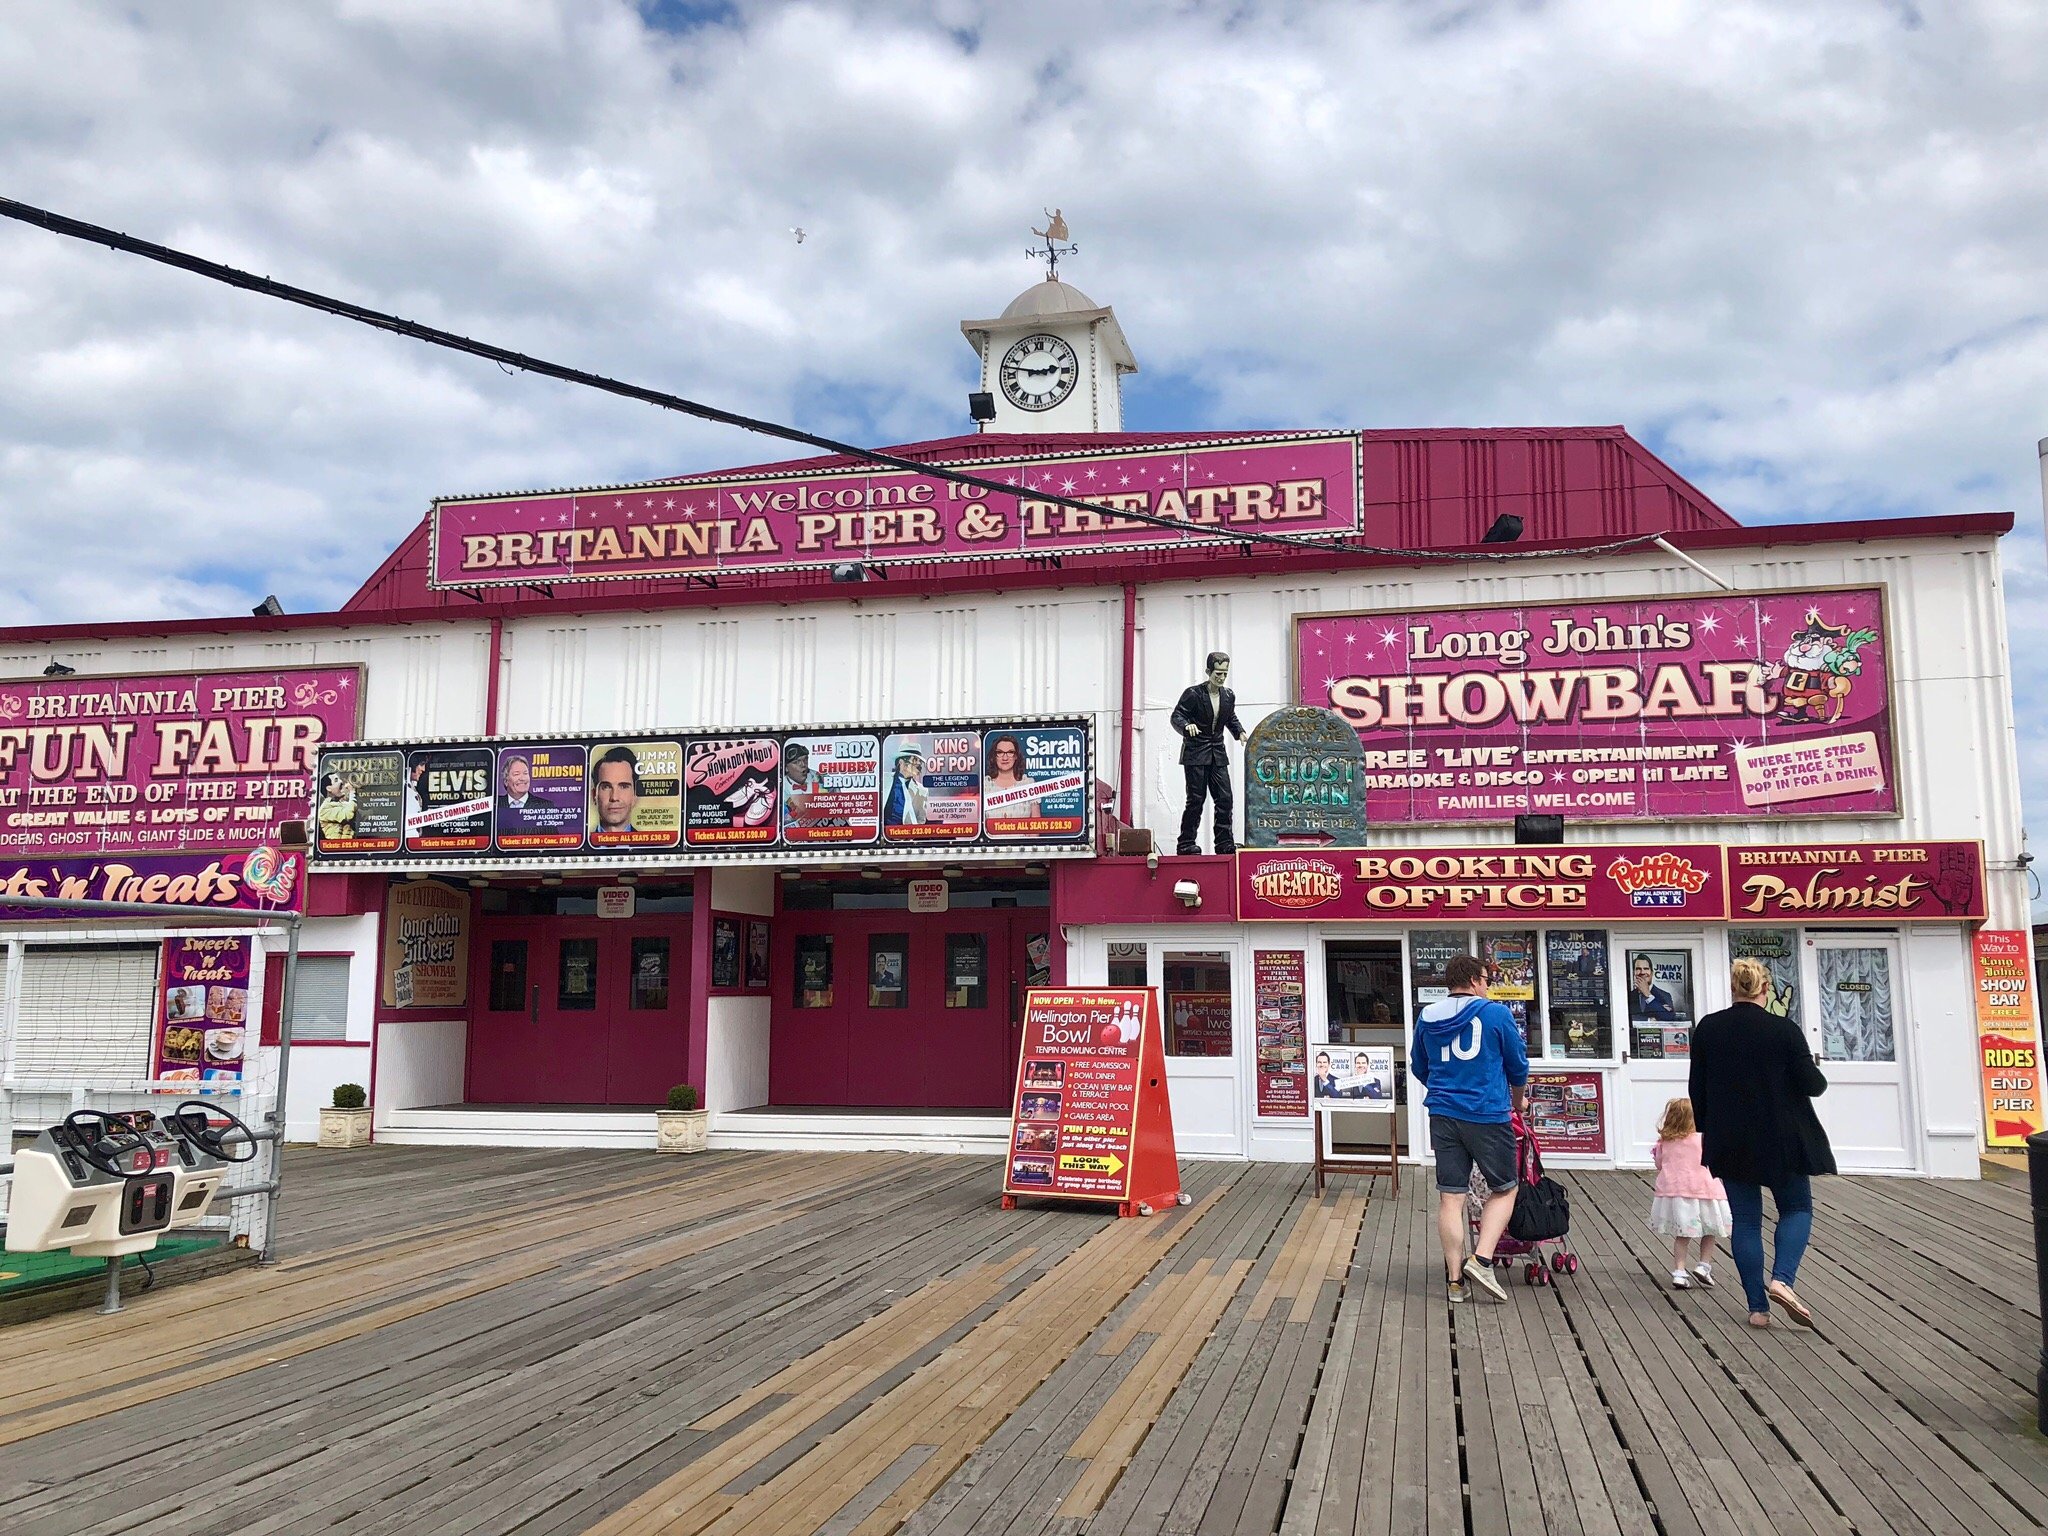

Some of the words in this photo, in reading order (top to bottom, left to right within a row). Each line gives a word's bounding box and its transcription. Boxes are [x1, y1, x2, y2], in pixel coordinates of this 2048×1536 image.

[1026, 247, 1036, 259] N
[1072, 244, 1078, 254] S
[730, 475, 935, 514] Welcome
[462, 517, 779, 571] BRITANNIA
[797, 506, 943, 553] PIER
[957, 501, 1006, 540] &
[1024, 478, 1325, 538] THEATRE
[1408, 624, 1530, 665] Long
[1542, 614, 1692, 655] John's
[1331, 661, 1778, 728] SHOWBAR
[27, 690, 198, 720] BRITANNIA
[212, 687, 286, 711] PIER
[0, 722, 137, 781] FUN
[152, 715, 326, 778] FAIR
[812, 744, 833, 753] LIVE
[835, 741, 874, 759] ROY
[934, 738, 968, 754] KING
[1026, 735, 1080, 756] Sarah
[532, 753, 550, 765] JIM
[636, 750, 677, 761] JIMMY
[1366, 749, 1428, 769] REE
[1524, 744, 1718, 765] ENTERTAINMENT
[1747, 754, 1793, 768] WHERE
[1796, 749, 1820, 761] THE
[1824, 743, 1867, 758] STARS
[328, 757, 398, 772] SUPREME
[634, 762, 677, 775] CARR
[818, 761, 877, 775] CHUBBY
[927, 757, 945, 772] OF
[949, 757, 976, 772] POP
[1025, 757, 1081, 770] MILLICAN
[1256, 755, 1358, 783] GHOST
[1763, 768, 1779, 779] OF
[1783, 761, 1824, 776] STAGE
[1837, 757, 1853, 768] TV
[532, 765, 583, 778] DAVIDSON
[1366, 772, 1454, 788] ARAOKE
[1474, 770, 1544, 786] DISCO
[1572, 768, 1635, 783] OPEN
[1643, 768, 1663, 782] til
[1670, 765, 1729, 781] LATE
[348, 772, 398, 787] QUEEN
[428, 769, 488, 792] ELVIS
[823, 775, 876, 789] BROWN
[1746, 781, 1771, 794] POP
[1776, 779, 1790, 790] IN
[1794, 775, 1819, 787] FOR
[1836, 766, 1878, 781] DRINK
[0, 788, 21, 806] AT
[30, 785, 77, 806] THE
[85, 784, 137, 804] END
[144, 782, 178, 802] OF
[186, 781, 237, 801] THE
[244, 779, 306, 799] PIER
[429, 792, 460, 800] WORLD
[987, 797, 1004, 806] NEW
[1005, 791, 1027, 803] DATES
[1029, 783, 1059, 798] COMING
[1060, 776, 1081, 790] SOON
[1265, 783, 1351, 805] TRAIN
[1438, 794, 1529, 810] FAMILIES
[1533, 792, 1636, 807] WELCOME
[7, 810, 68, 827] GREAT
[73, 809, 130, 825] VALUE
[151, 808, 199, 823] LOTS
[203, 807, 229, 822] OF
[234, 806, 273, 821] FUN
[408, 817, 423, 827] NEW
[423, 812, 443, 823] DATES
[444, 805, 471, 818] COMING
[471, 801, 490, 812] SOON
[48, 831, 91, 845] GHOST
[95, 829, 134, 844] TRAIN,
[138, 828, 175, 842] GIANT
[178, 828, 213, 842] SLIDE
[229, 827, 266, 841] MUCH
[1739, 850, 1863, 865] BRITANNIA
[1873, 848, 1928, 863] PIER
[1260, 860, 1308, 875] Britannia
[1313, 861, 1333, 874] Pier
[1355, 854, 1596, 881] BOOKING
[103, 862, 240, 903] Treats
[1254, 871, 1338, 896] THEATRE
[1740, 868, 1928, 912] Palmist
[1367, 884, 1587, 908] OFFICE
[1634, 896, 1682, 904] PARK
[182, 937, 240, 951] Sweets
[1568, 932, 1584, 941] JIM
[1741, 935, 1783, 946] Romany
[1988, 935, 2010, 943] This
[1551, 941, 1602, 950] DAVIDSON
[1980, 944, 2004, 952] Way
[1416, 948, 1463, 959] DRIFTERS
[183, 965, 232, 980] Treats
[1654, 964, 1682, 972] JIMMY
[1654, 972, 1682, 980] CARR
[1981, 980, 2026, 991] SHOW
[1033, 997, 1052, 1005] NOW
[1053, 997, 1074, 1005] OPEN
[1081, 997, 1096, 1005] The
[1989, 994, 2020, 1006] BAR
[1030, 1009, 1087, 1027] Wellington
[1090, 1010, 1112, 1023] Pier
[1042, 1024, 1092, 1044] Bowl
[1035, 1046, 1059, 1054] TENPIN
[1060, 1046, 1097, 1055] BOWLING
[1098, 1047, 1127, 1056] CENTRE
[1984, 1049, 2035, 1067] RIDES
[1075, 1061, 1091, 1069] FREE
[1092, 1062, 1130, 1070] ADMISSION
[1074, 1072, 1094, 1080] BOWL
[1073, 1083, 1096, 1091] OCEAN
[1990, 1078, 2032, 1090] END
[1071, 1102, 1108, 1110] AMERICAN
[1109, 1103, 1129, 1111] POOL
[1993, 1098, 2034, 1111] PIER
[1070, 1113, 1095, 1121] GAMES
[1063, 1125, 1084, 1133] FUN
[1086, 1126, 1107, 1134] FOR
[1109, 1127, 1128, 1136] ALL
